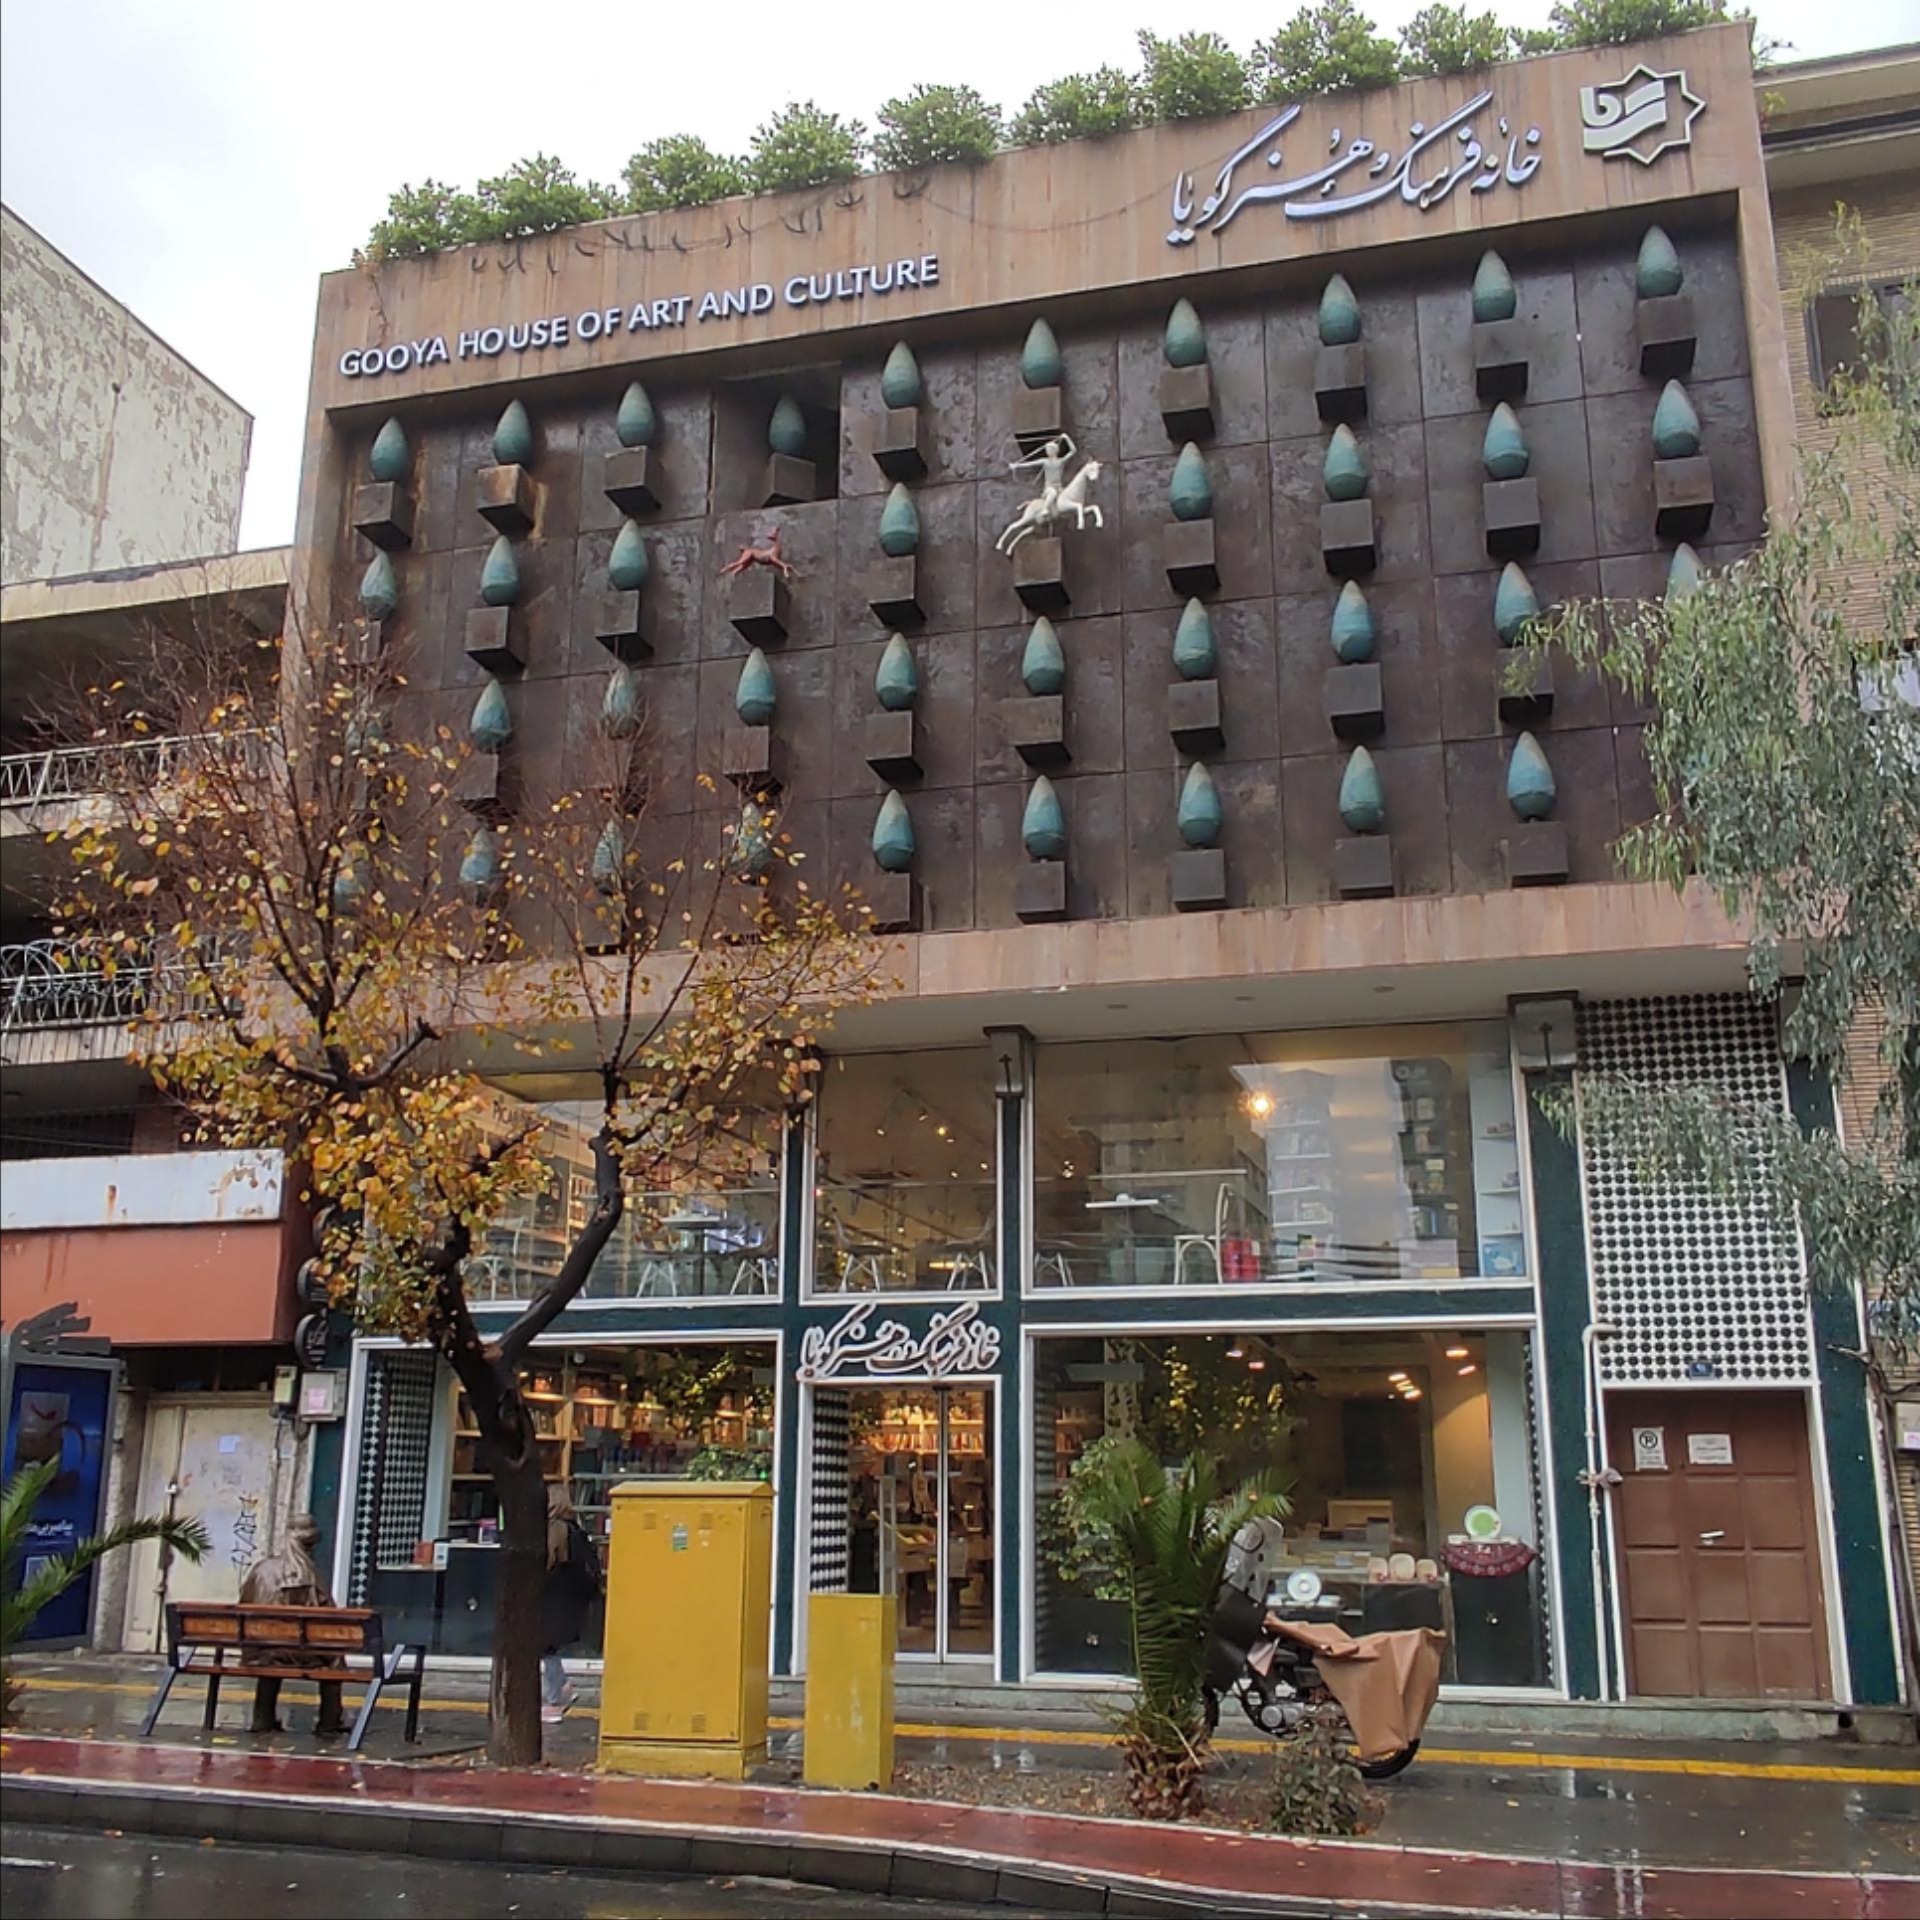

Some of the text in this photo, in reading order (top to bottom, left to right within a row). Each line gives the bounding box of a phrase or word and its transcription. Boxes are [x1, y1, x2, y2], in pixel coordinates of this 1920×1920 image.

[1166, 104, 1301, 245] گویا
[1284, 90, 1494, 218] فرهنگ
[1369, 151, 1390, 176] و
[340, 254, 939, 377] GOOYA HOUSE OF ART AND CULTURE
[796, 1301, 877, 1381] گویا
[866, 1300, 980, 1379] فرهنگ
